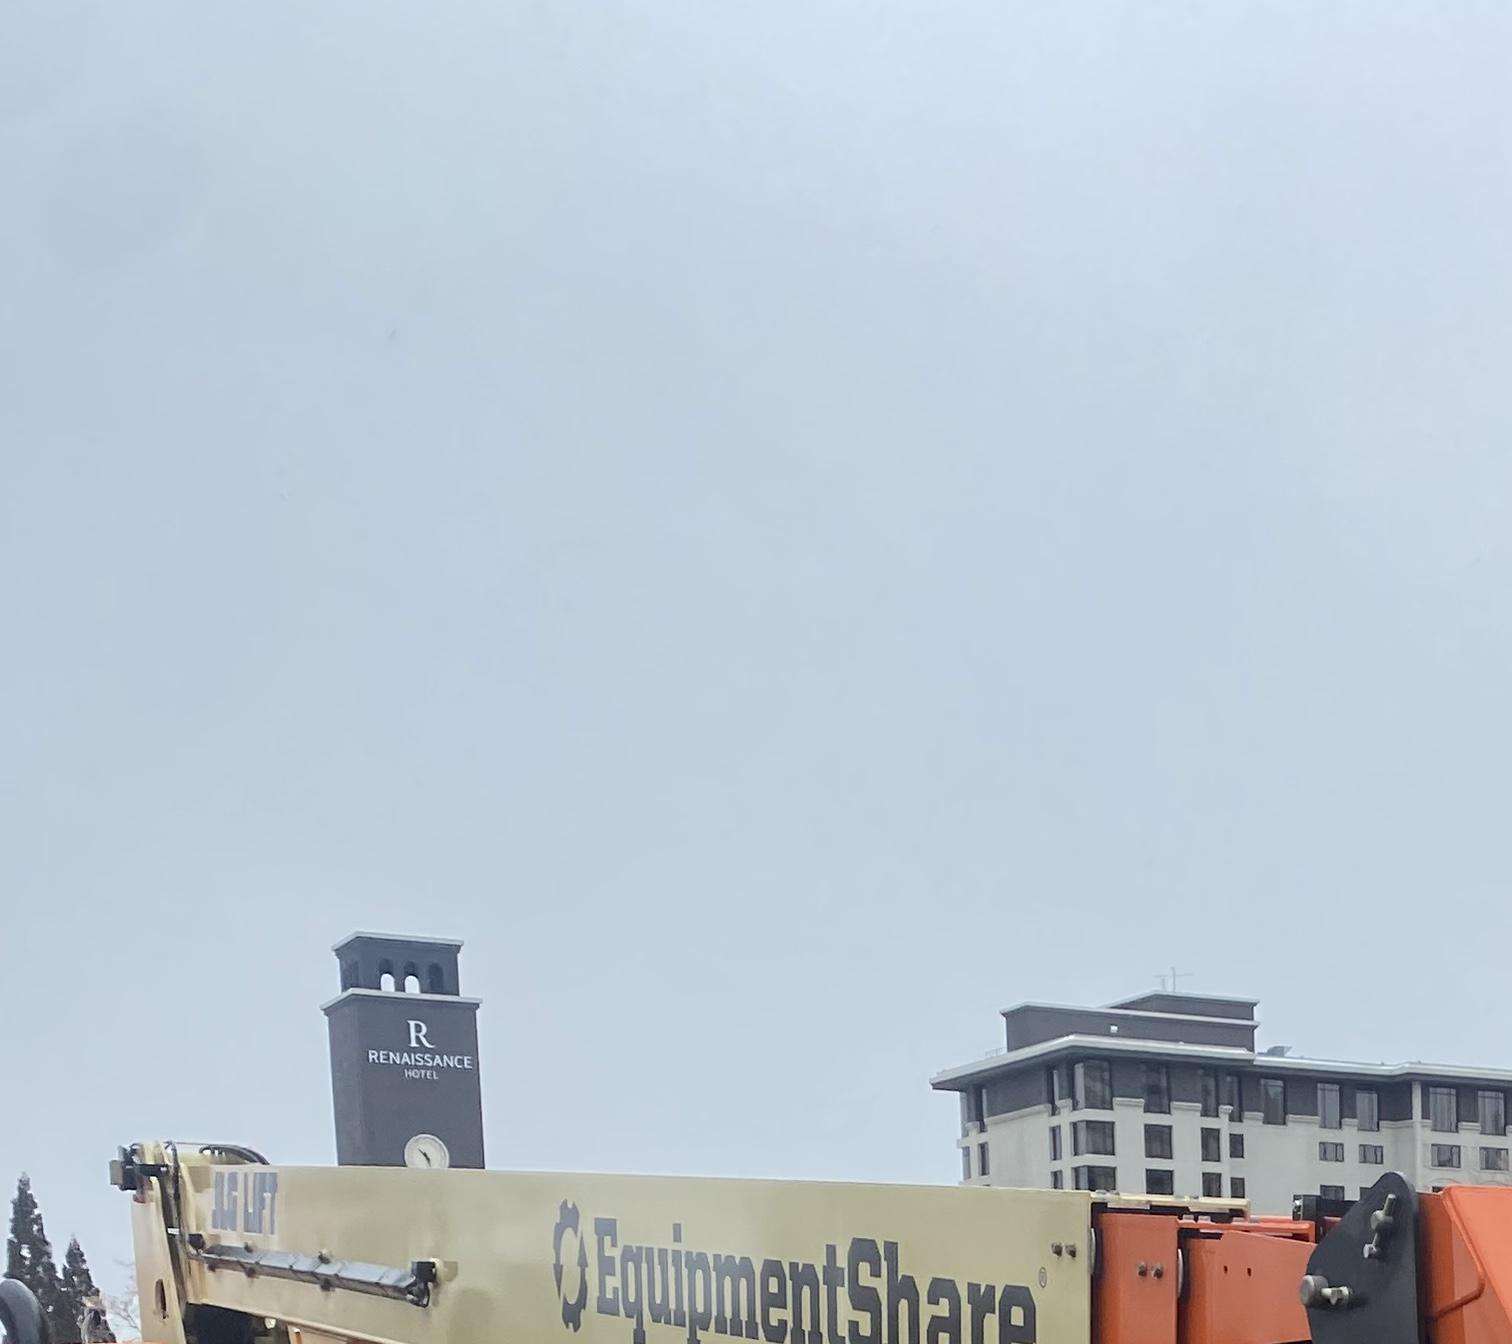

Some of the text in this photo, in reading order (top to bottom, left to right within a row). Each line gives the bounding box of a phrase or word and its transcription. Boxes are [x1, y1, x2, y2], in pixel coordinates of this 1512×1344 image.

[407, 1020, 435, 1048] R
[368, 1050, 473, 1069] RENAISSANCE
[404, 1068, 439, 1080] HOTEL
